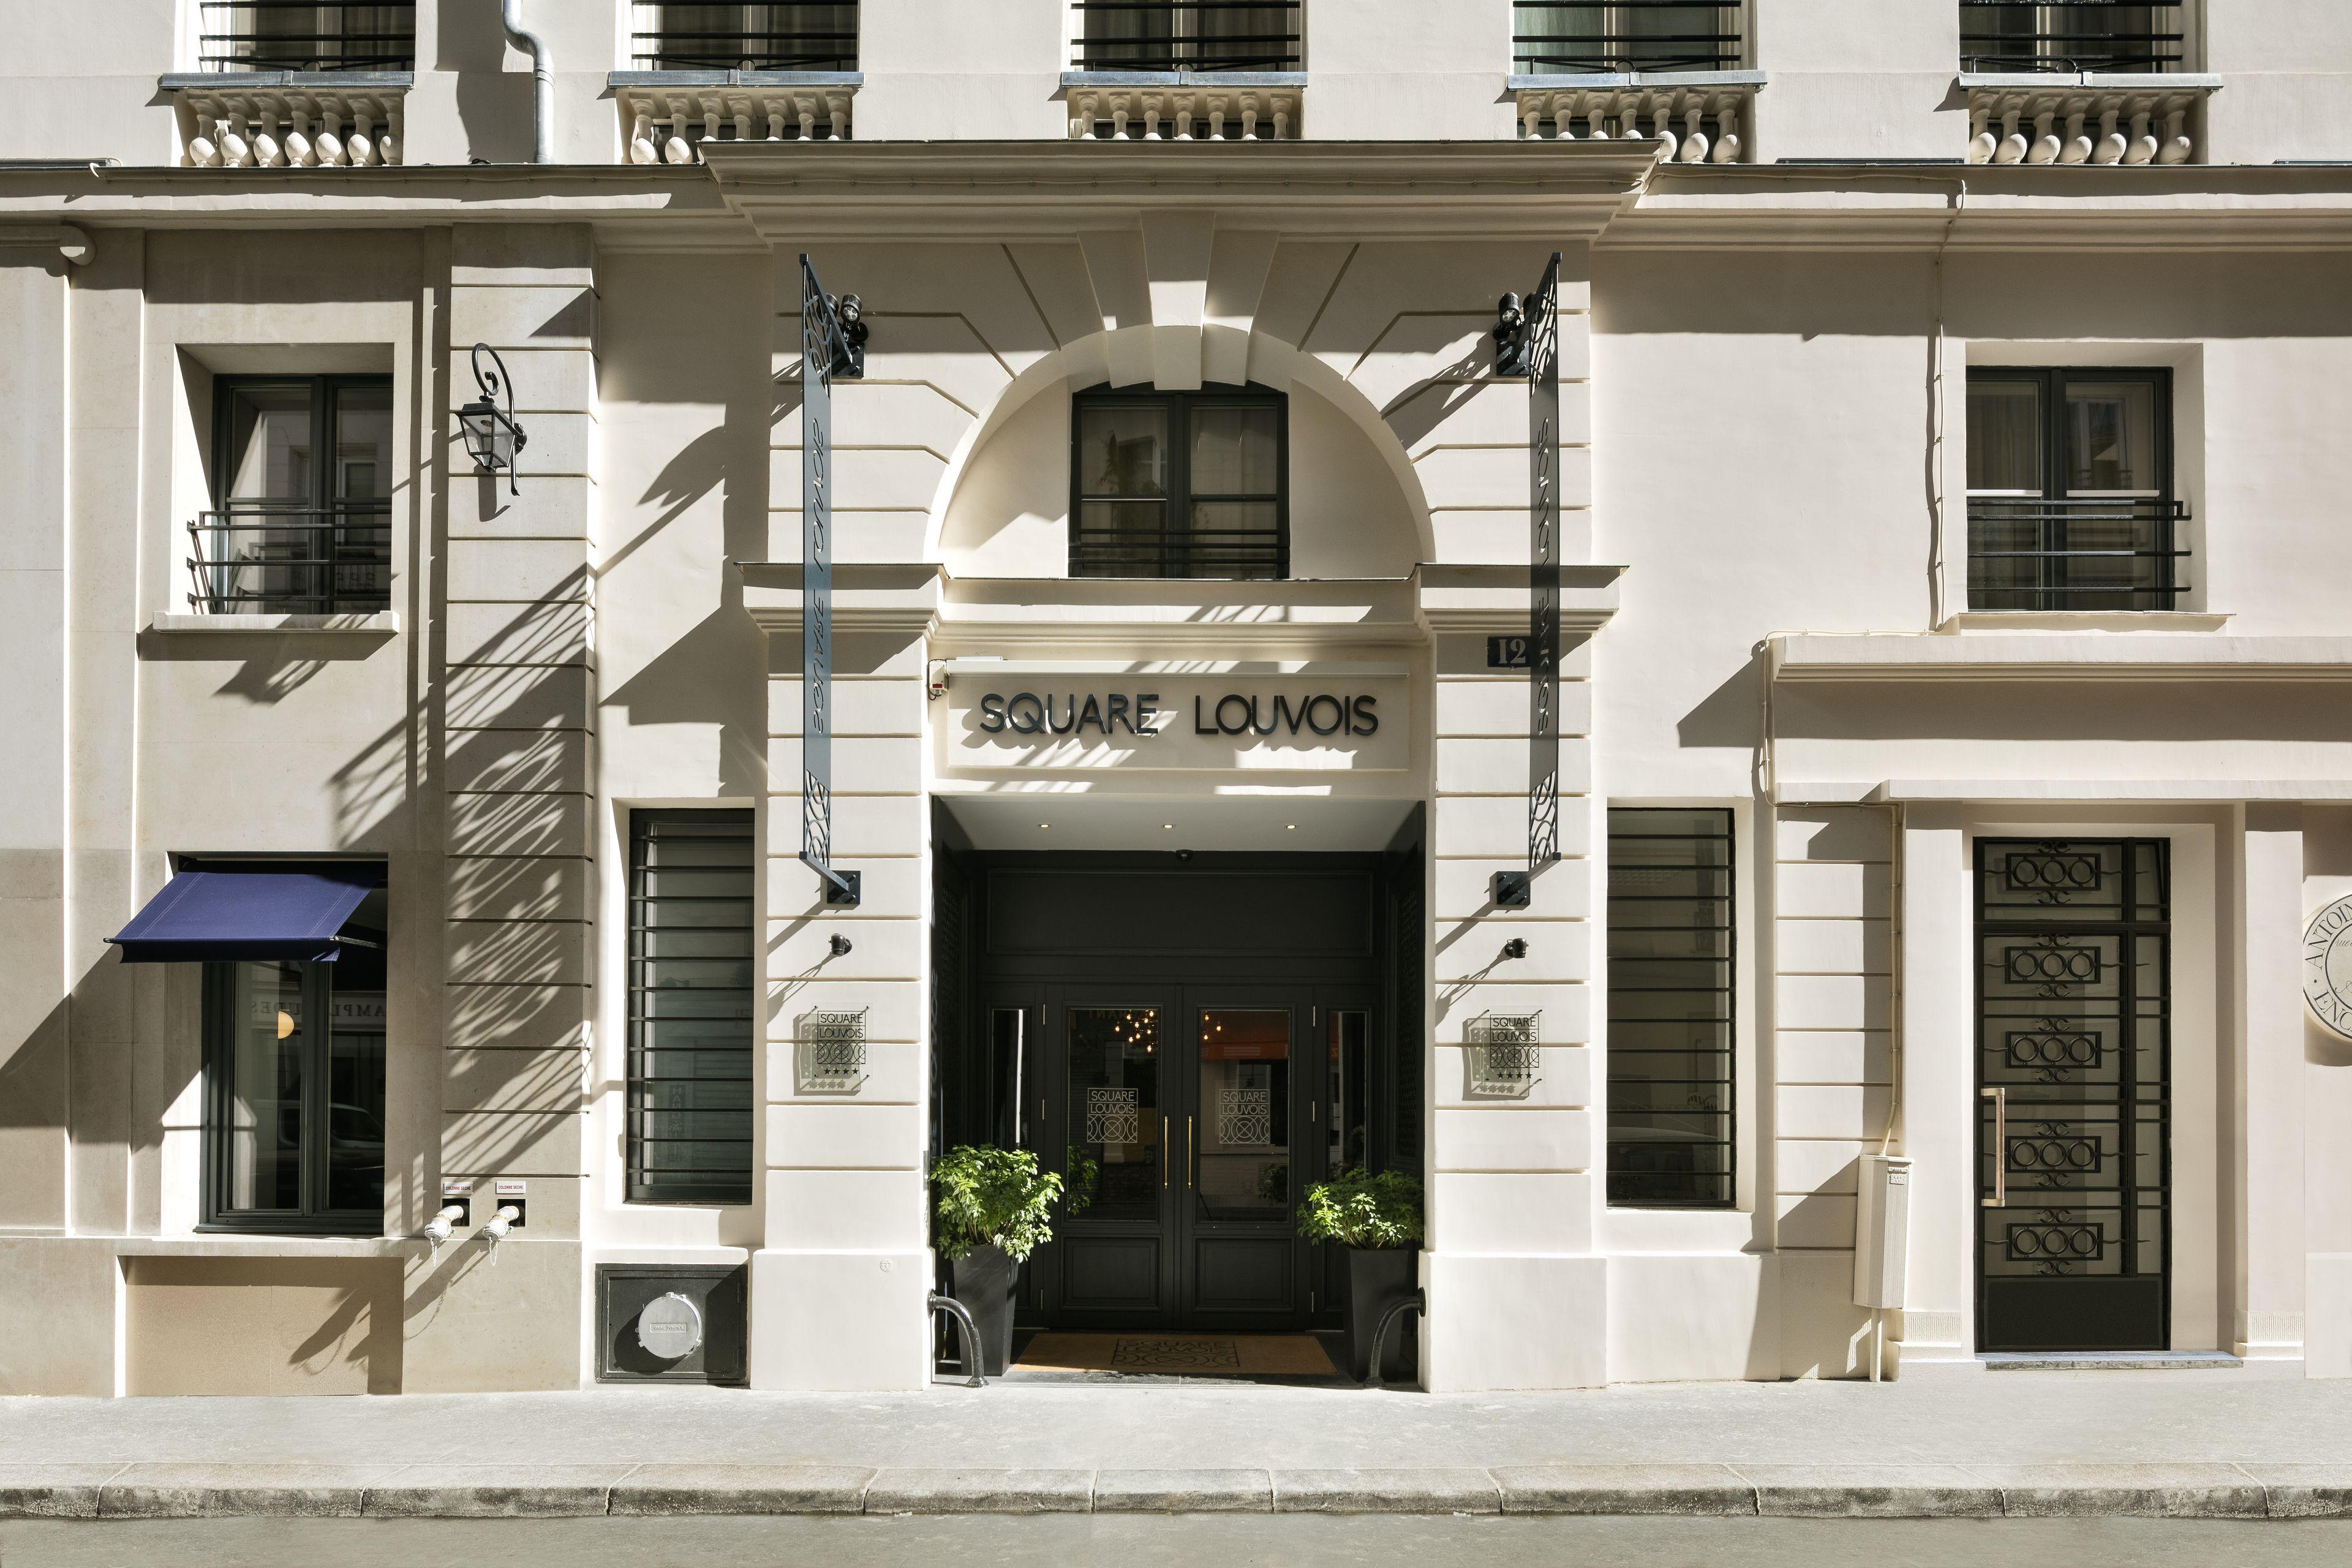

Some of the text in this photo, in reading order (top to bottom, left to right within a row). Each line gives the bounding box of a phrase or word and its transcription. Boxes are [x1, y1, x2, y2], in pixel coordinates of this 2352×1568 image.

[1538, 417, 1549, 572] LOUVOIS
[1498, 639, 1526, 664] 12
[980, 692, 1379, 736] SQUARE LOUVOIS
[2312, 989, 2352, 1031] ENC
[820, 1013, 864, 1023] SQUARE
[1493, 1017, 1536, 1027] SQUARE
[820, 1028, 864, 1038] LOUVOIS
[1492, 1031, 1537, 1042] LOUVOIS
[1091, 1091, 1135, 1101] SQUARE
[1223, 1091, 1266, 1102] SQUARE
[1090, 1103, 1135, 1114] LOUVOIS
[1222, 1104, 1267, 1115] LOUVOIS
